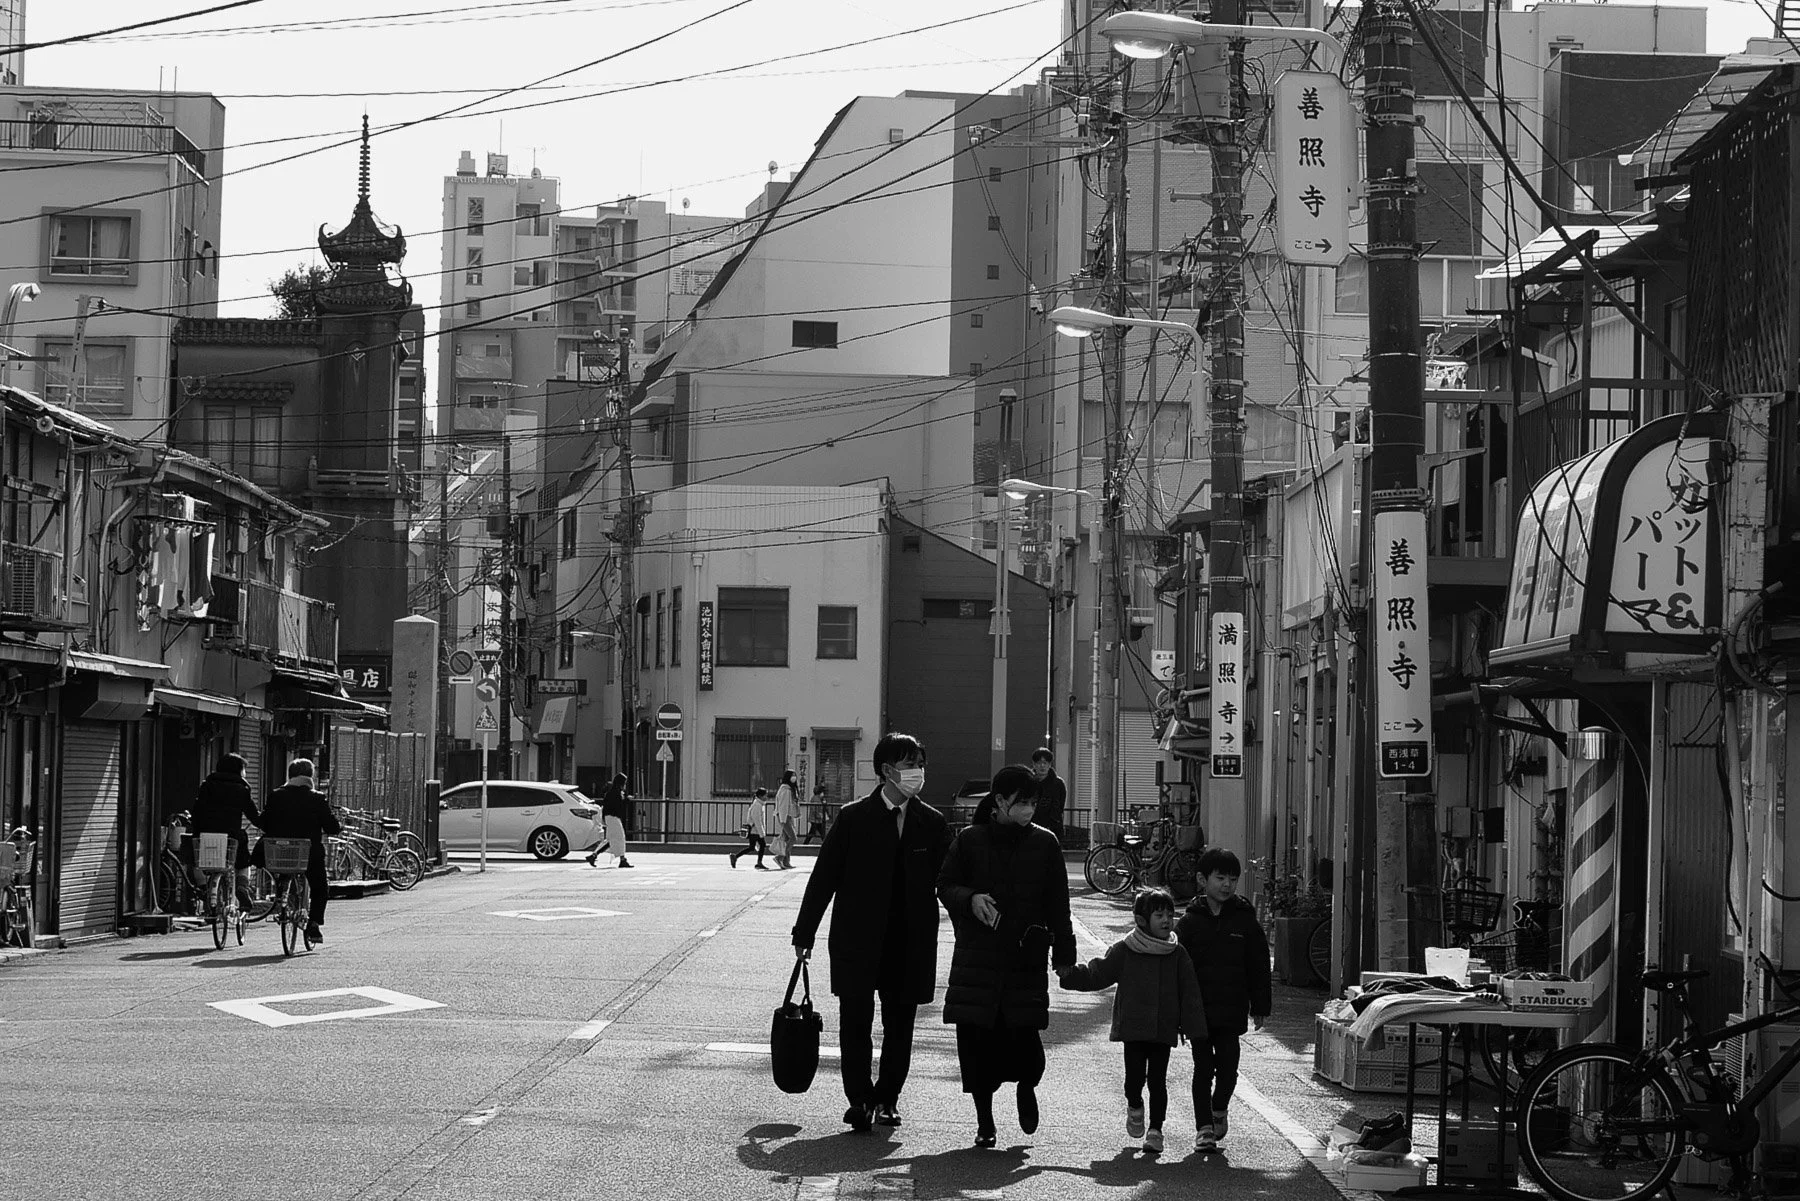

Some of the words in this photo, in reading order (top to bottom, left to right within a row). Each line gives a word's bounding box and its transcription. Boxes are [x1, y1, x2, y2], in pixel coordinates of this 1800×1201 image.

[1297, 87, 1327, 218] 善照寺
[1294, 240, 1313, 250] ここ
[1622, 510, 1663, 631] パーマ
[1385, 538, 1418, 690] 善照寺
[1217, 622, 1238, 725] 満照寺
[1383, 721, 1402, 731] ここ
[1388, 748, 1419, 759] 西浅草
[1393, 760, 1416, 771] 1-4
[1519, 995, 1588, 1006] STARBUCKS
